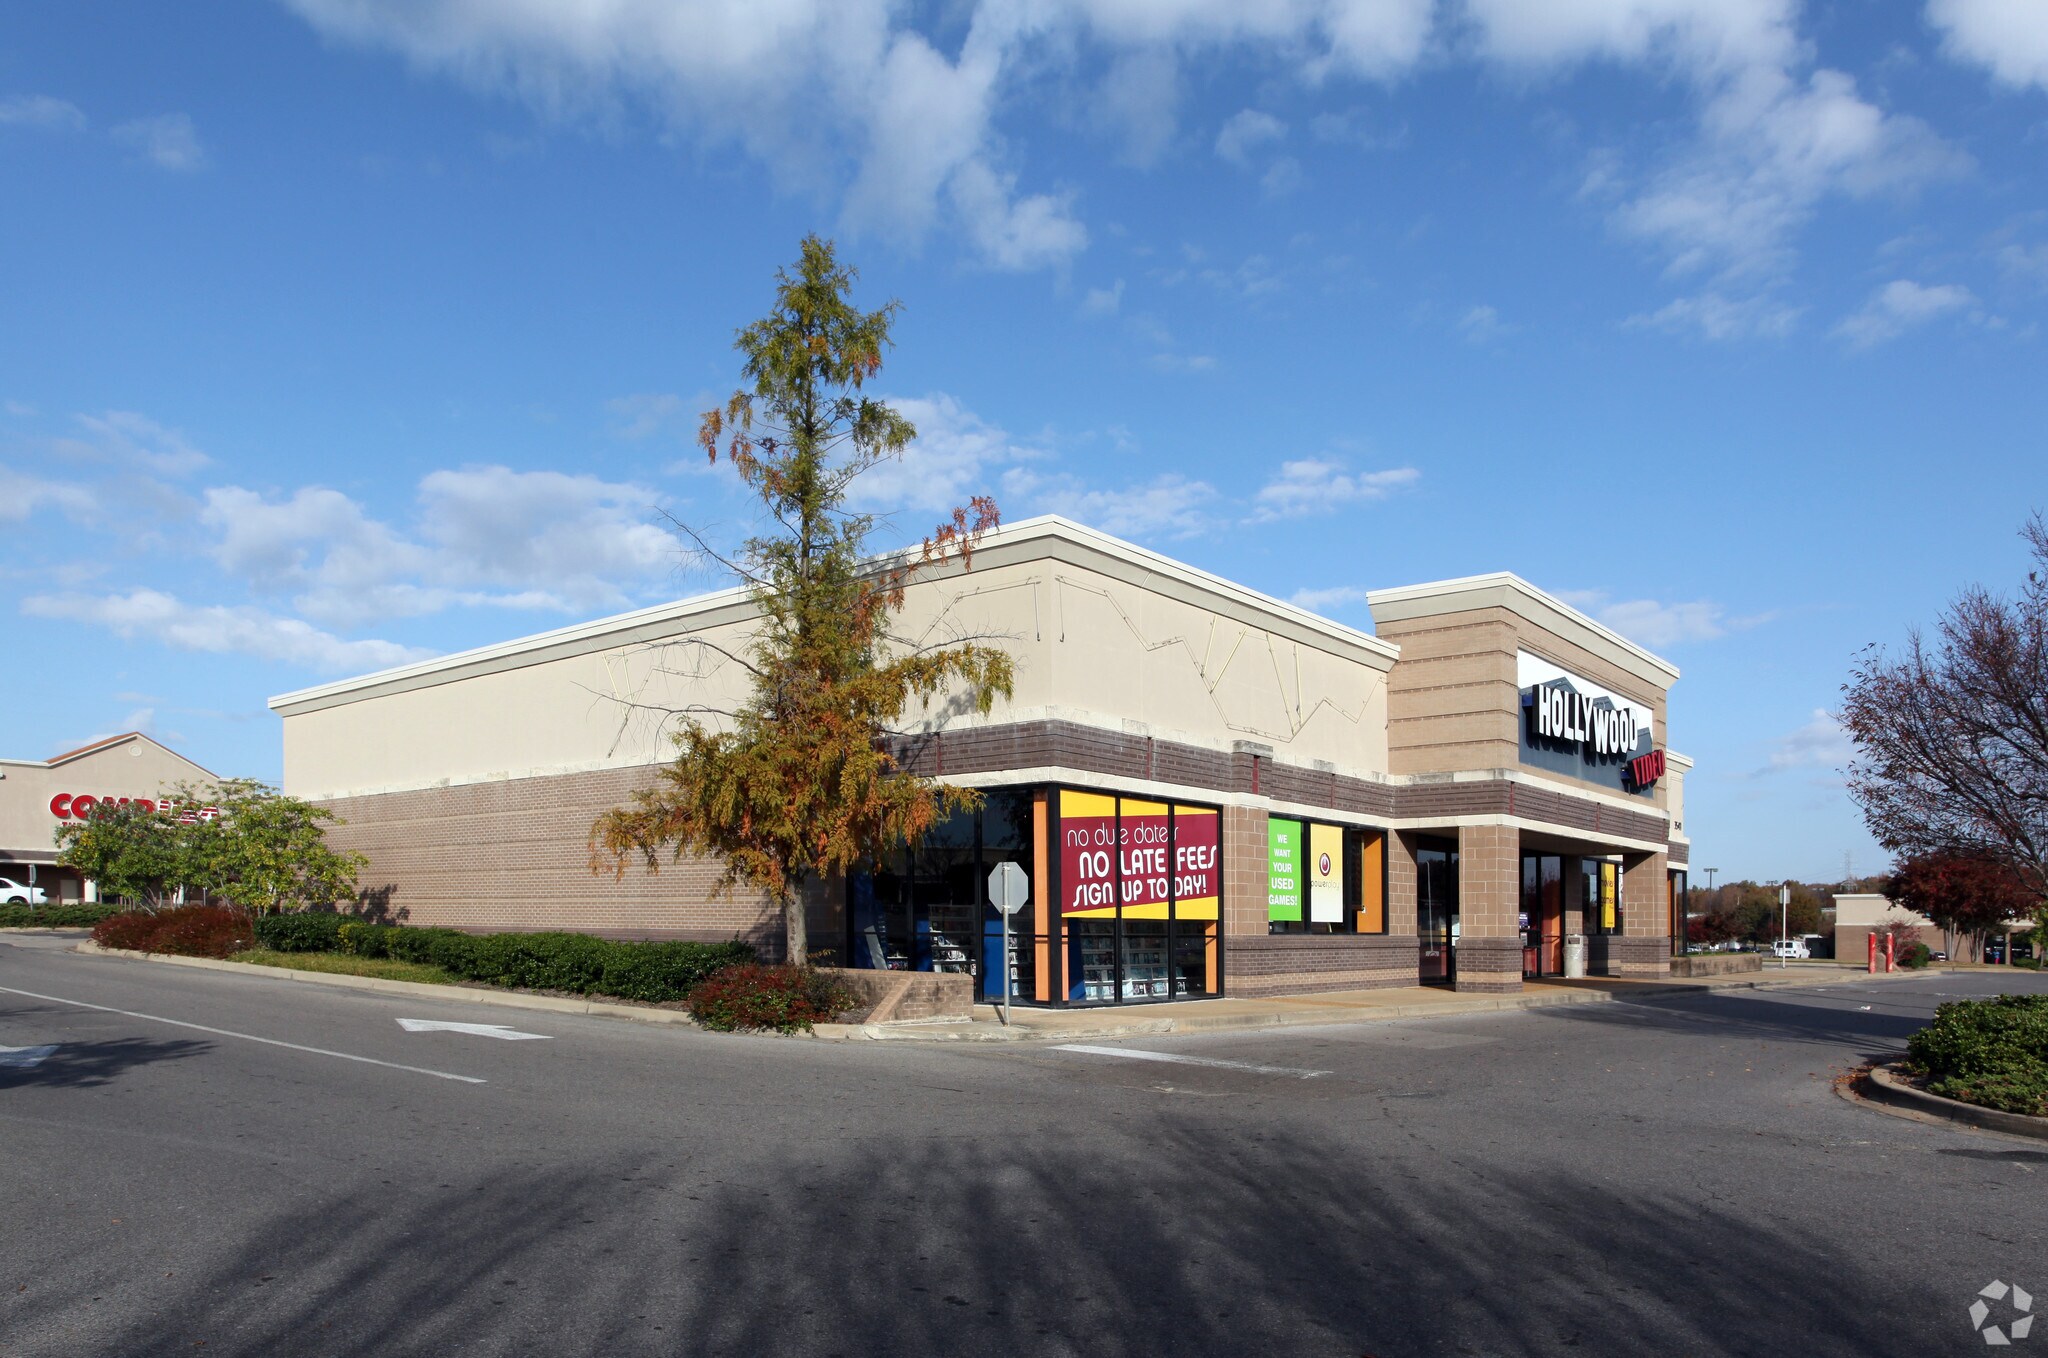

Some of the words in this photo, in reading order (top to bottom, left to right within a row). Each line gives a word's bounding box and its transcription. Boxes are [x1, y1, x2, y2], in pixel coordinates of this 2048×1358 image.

[1538, 684, 1638, 755] HOLLYWOOD
[1632, 748, 1666, 787] VIDEO
[1067, 829, 1089, 847] no
[1094, 822, 1129, 846] due
[1134, 821, 1179, 844] dates
[1277, 834, 1287, 844] WE
[1079, 850, 1110, 879] NO
[1120, 848, 1166, 876] LATE
[1177, 845, 1217, 872] FEES
[1274, 848, 1291, 858] WANT
[1273, 862, 1292, 873] YOUR
[1073, 881, 1114, 907] SIGN
[1122, 879, 1143, 902] UP
[1271, 877, 1294, 890] USED
[1268, 894, 1298, 906] GAMES!
